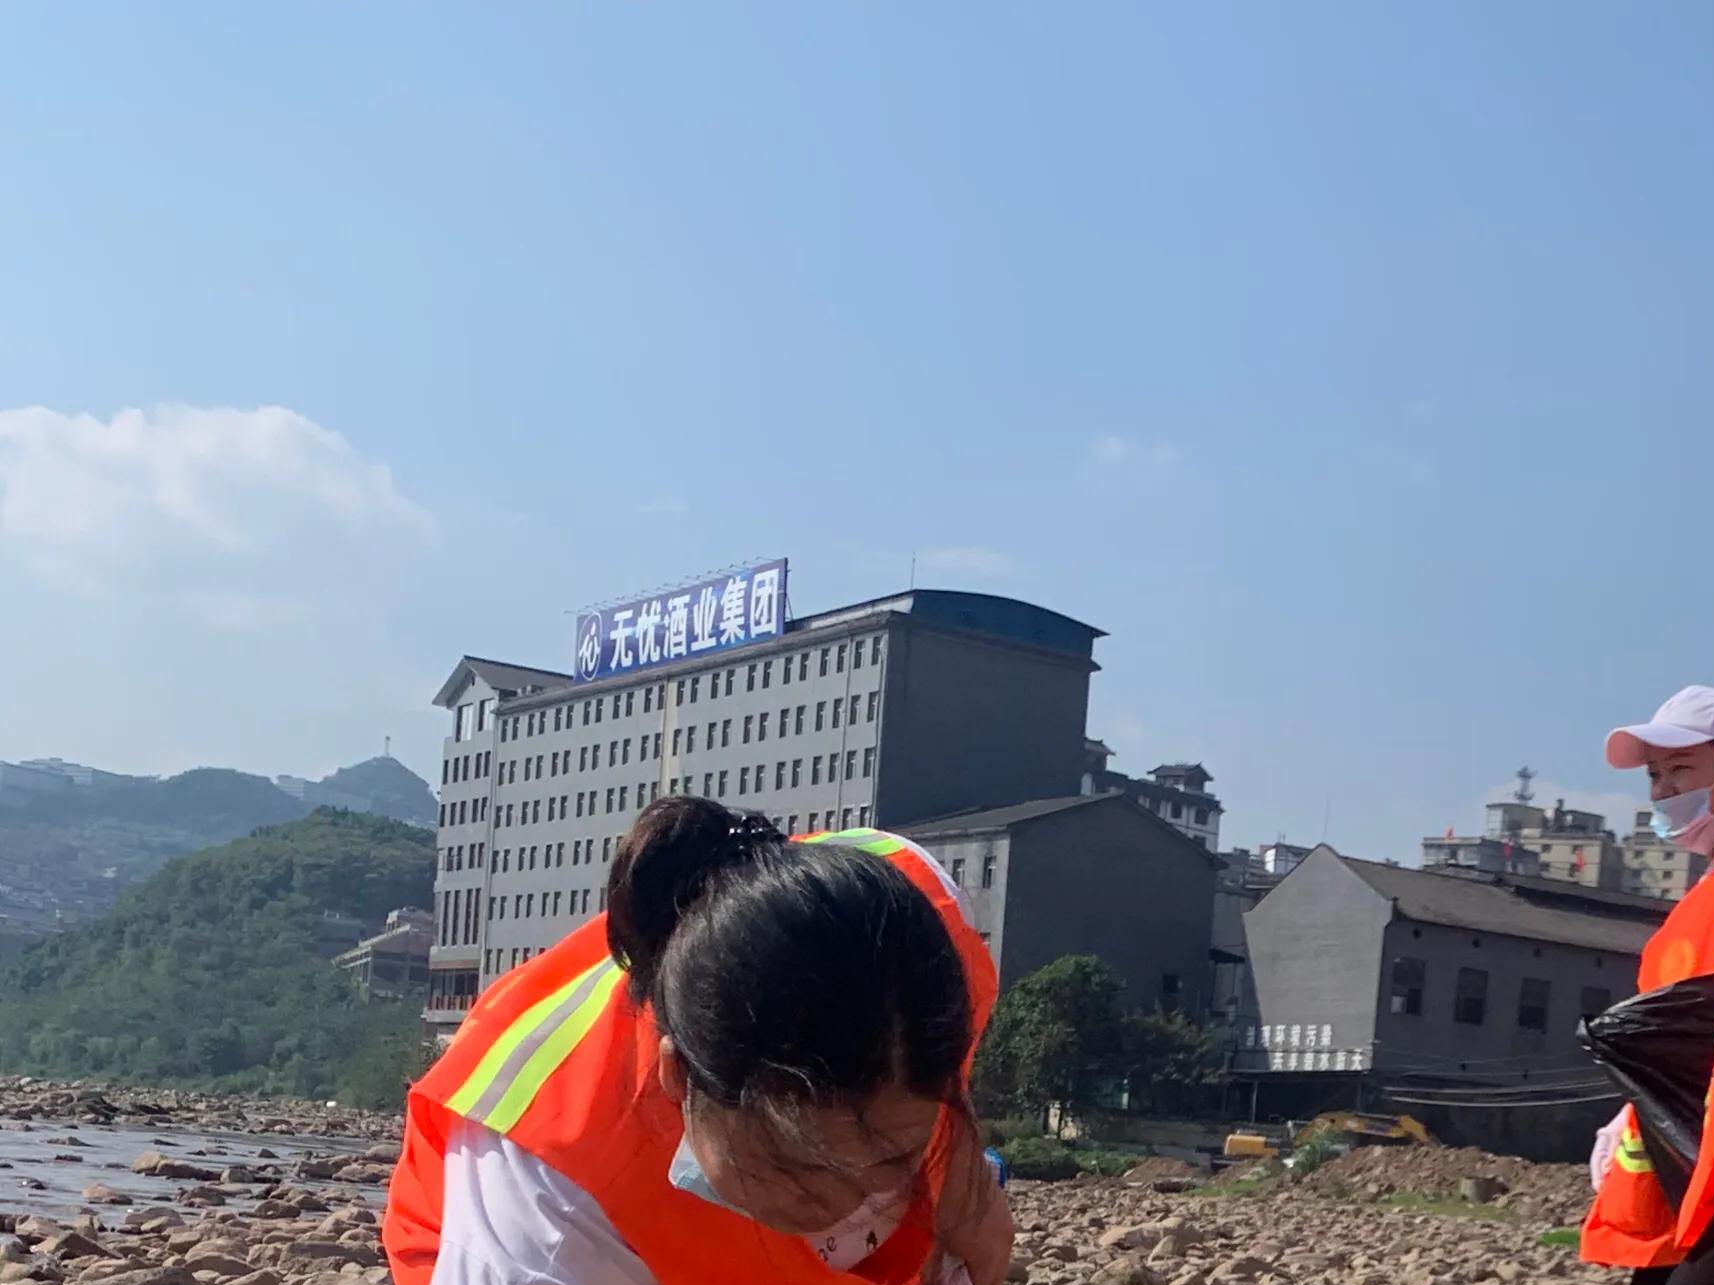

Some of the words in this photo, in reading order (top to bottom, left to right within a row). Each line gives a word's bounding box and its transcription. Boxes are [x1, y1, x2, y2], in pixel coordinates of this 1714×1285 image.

[609, 567, 780, 672] 无忧酒业集团
